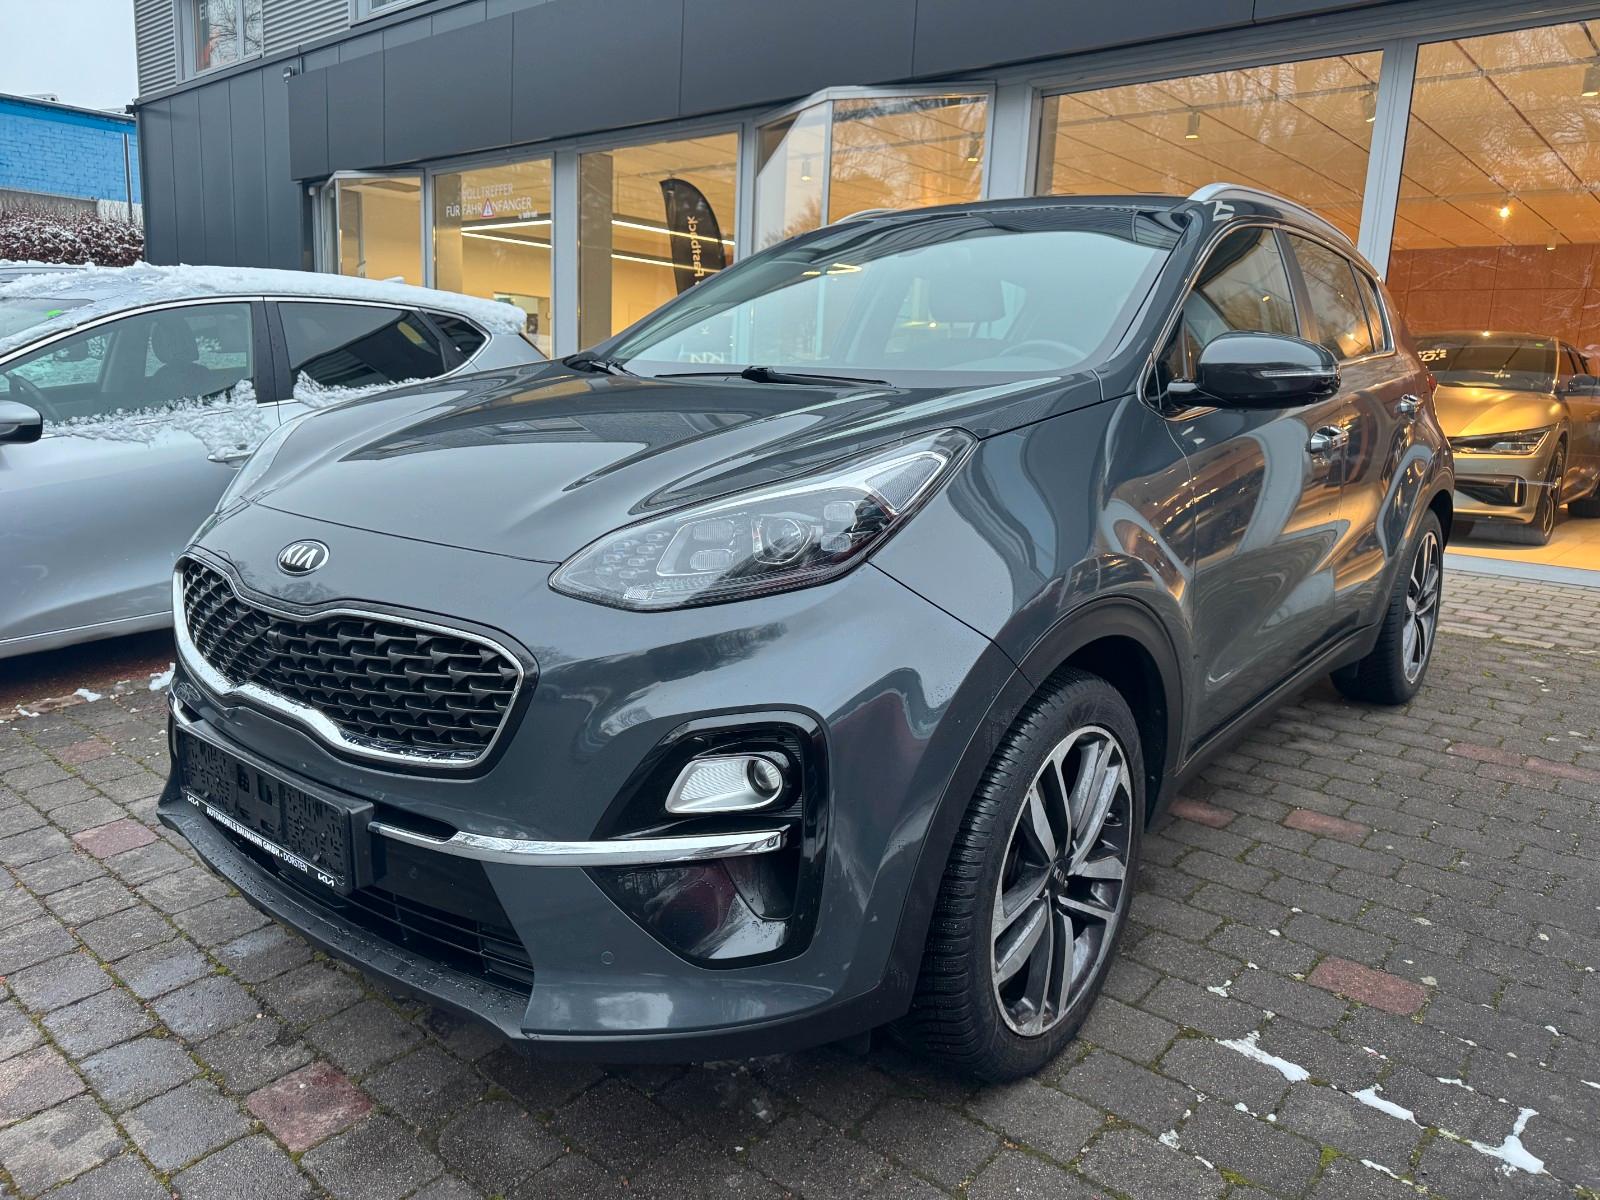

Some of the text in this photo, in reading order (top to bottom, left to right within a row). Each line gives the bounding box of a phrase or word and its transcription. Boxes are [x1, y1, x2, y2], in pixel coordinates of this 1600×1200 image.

[446, 202, 461, 218] FÜR
[280, 544, 319, 570] KIA
[283, 853, 308, 873] DORSTEN
